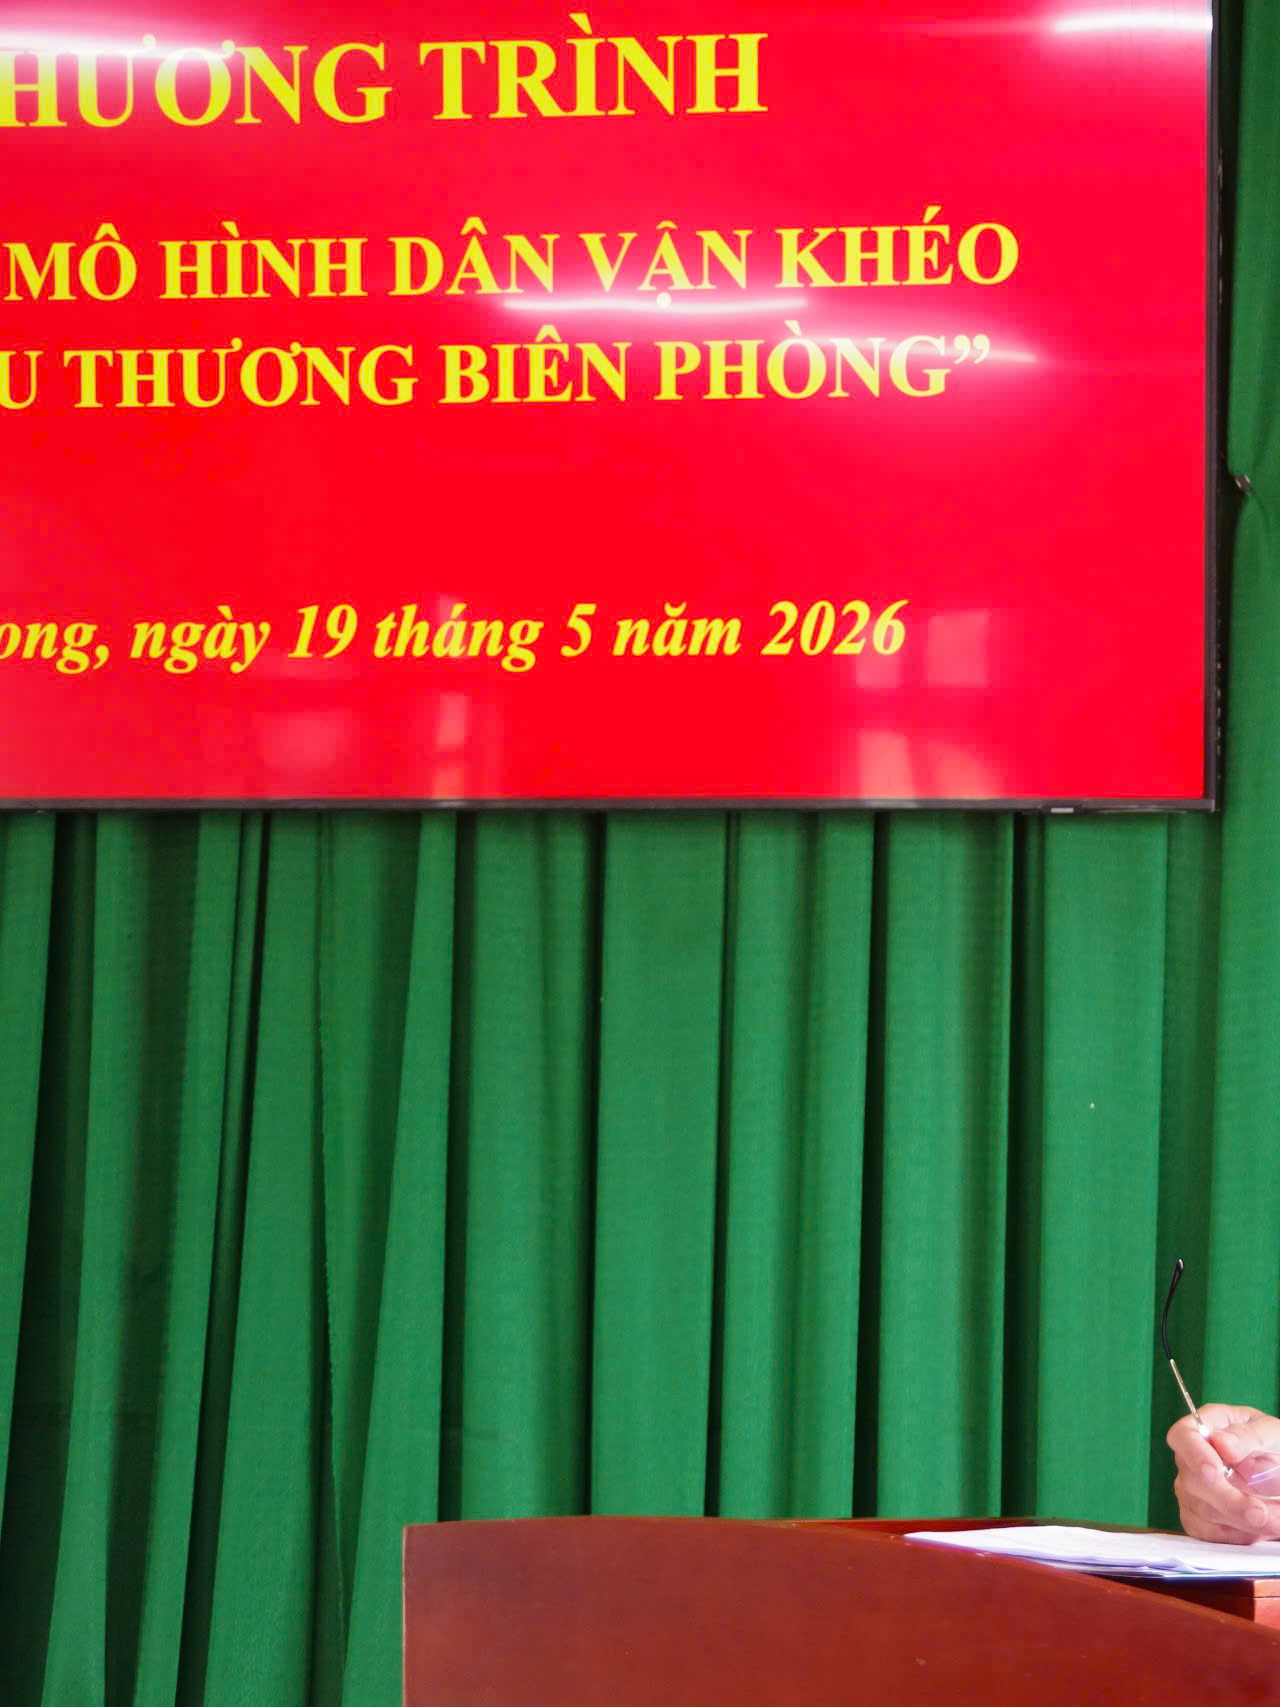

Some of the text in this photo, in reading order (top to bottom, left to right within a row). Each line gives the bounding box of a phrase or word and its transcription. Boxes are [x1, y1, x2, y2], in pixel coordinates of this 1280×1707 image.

[420, 13, 769, 121] TRÌNH
[3, 206, 1020, 309] MÔ HÌNH DÂN VẬN KHÉO
[64, 338, 419, 409] THƯƠNG
[440, 325, 629, 404] BIÊN
[130, 605, 272, 675] ngày
[288, 604, 358, 660] 19
[374, 602, 545, 674] tháng
[561, 604, 594, 659] 5
[613, 603, 743, 658] năm
[761, 600, 910, 658] 2026
